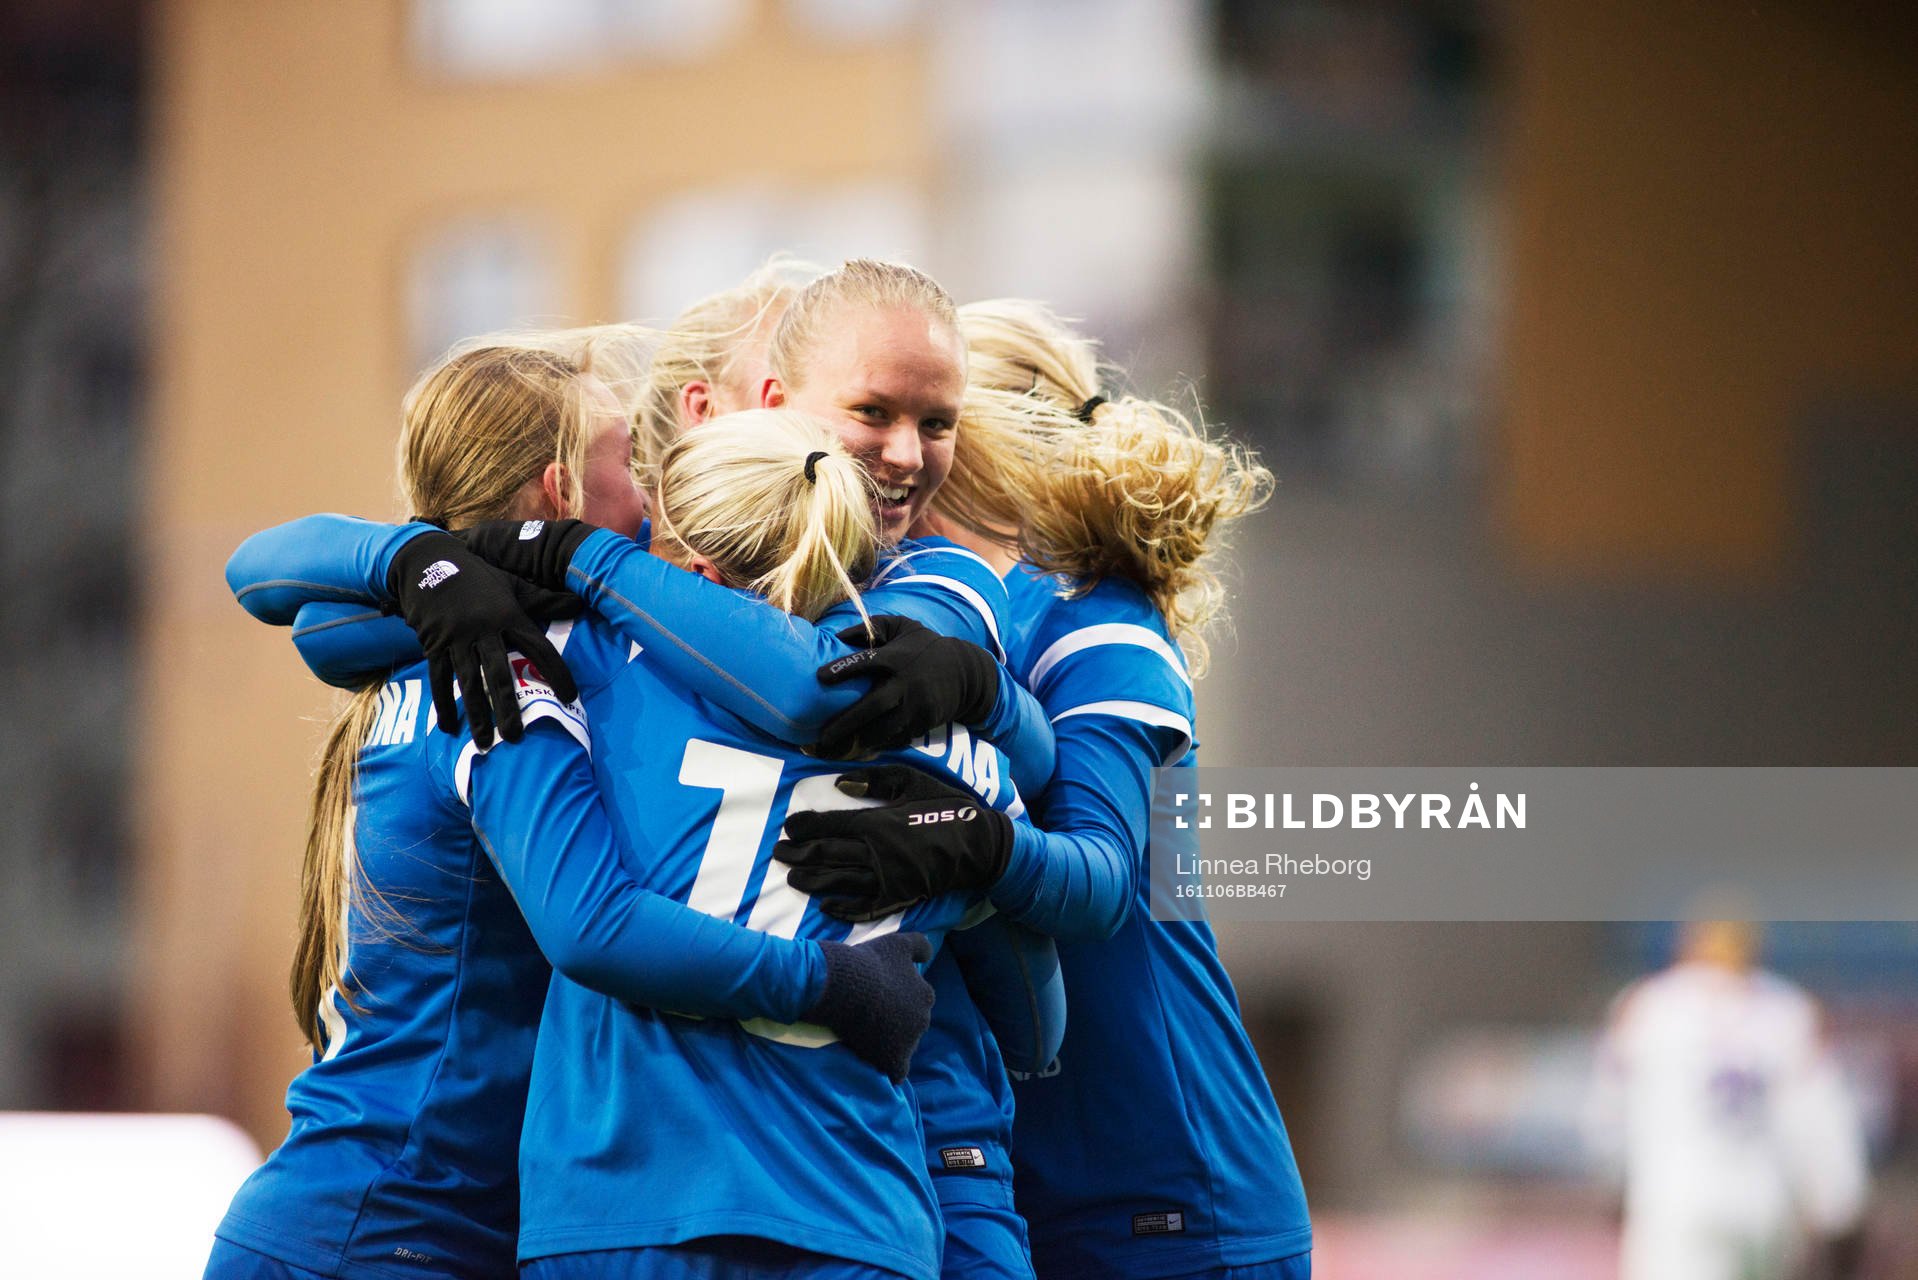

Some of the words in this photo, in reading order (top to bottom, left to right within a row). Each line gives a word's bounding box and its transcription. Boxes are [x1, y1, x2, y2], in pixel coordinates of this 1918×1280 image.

[422, 562, 440, 576] THE
[418, 569, 444, 590] NORTH
[428, 570, 449, 589] FACE
[830, 651, 865, 674] CRAFT
[908, 810, 955, 826] SOC
